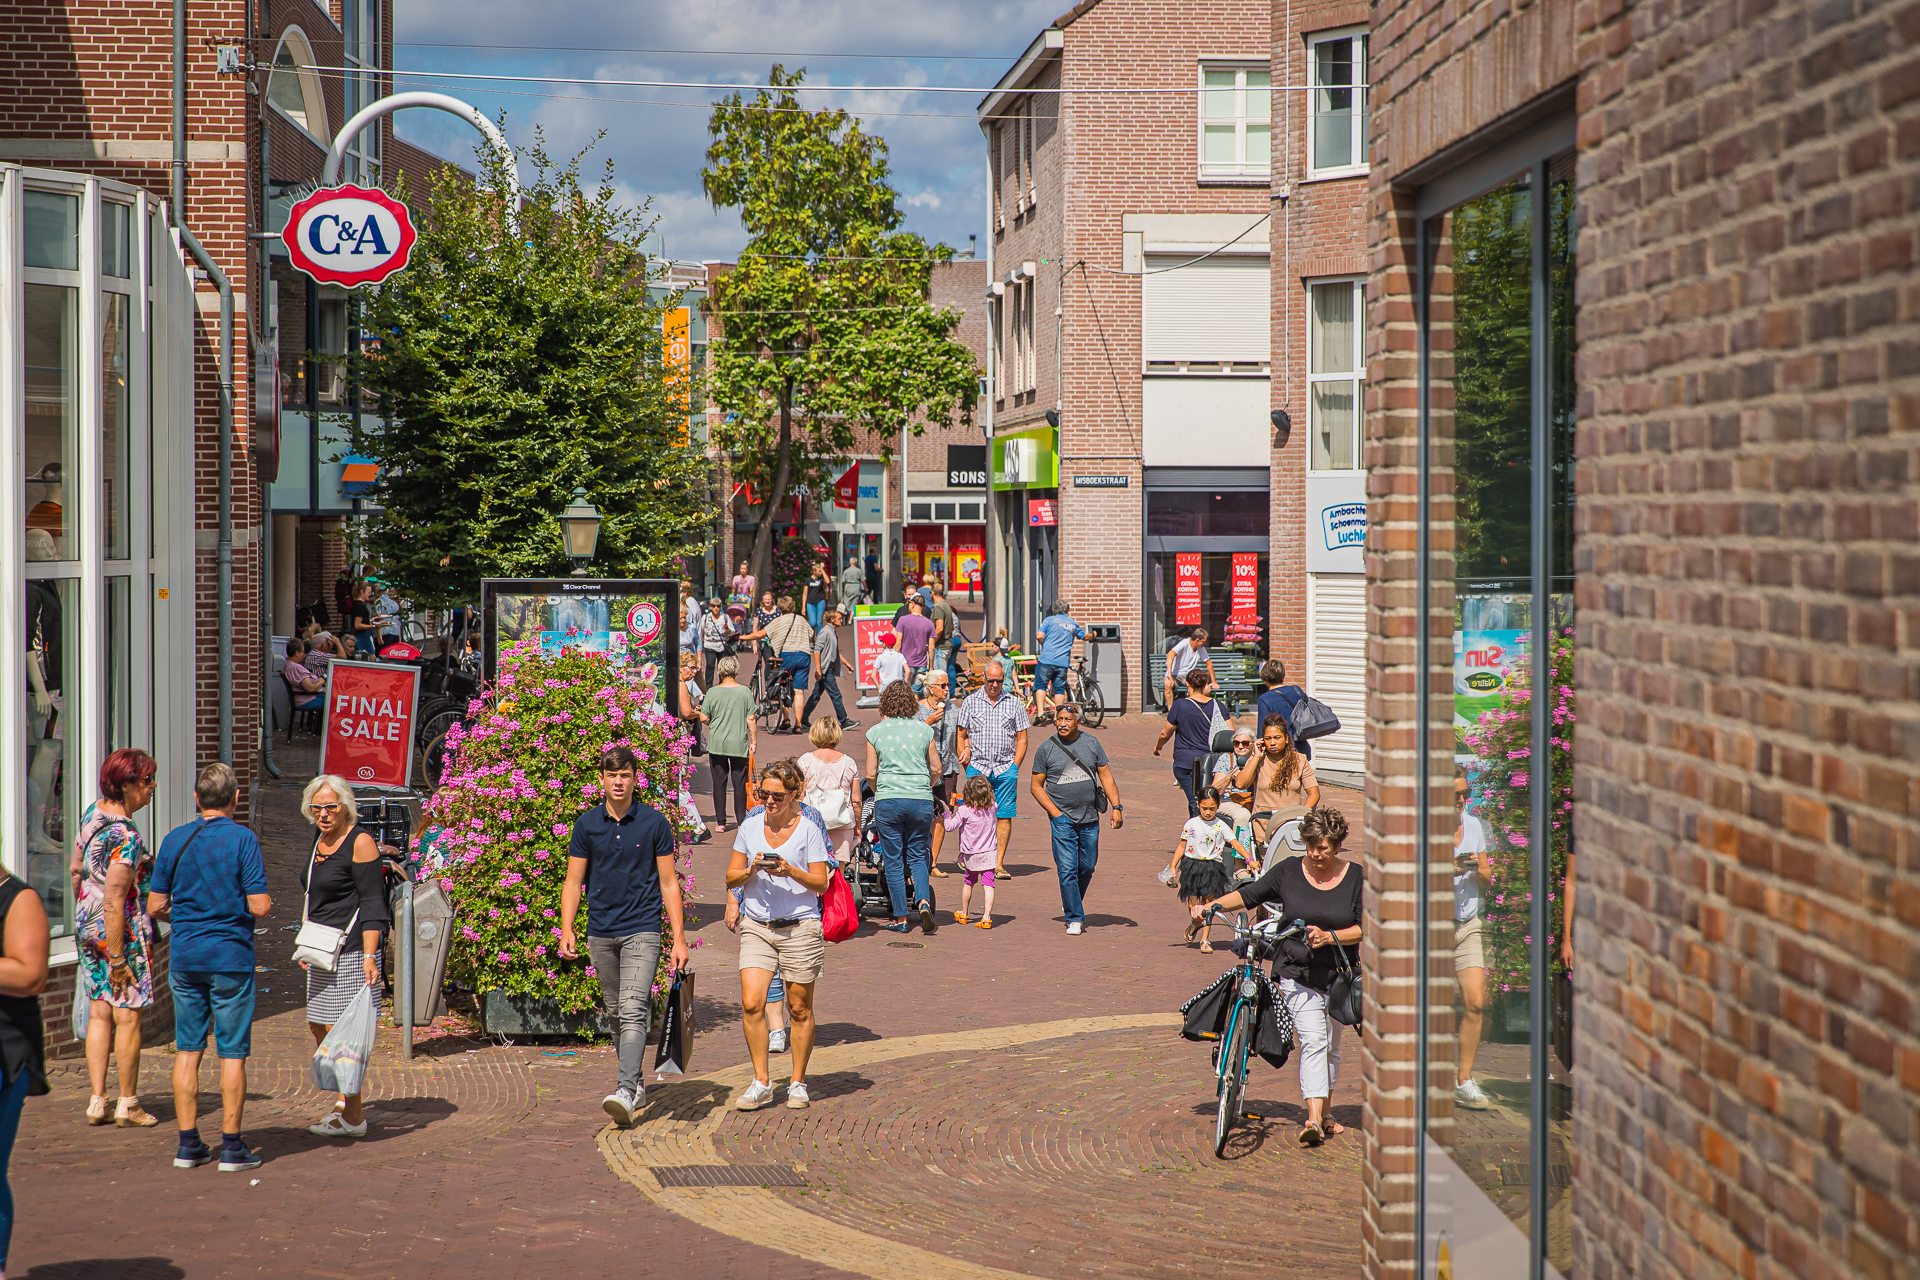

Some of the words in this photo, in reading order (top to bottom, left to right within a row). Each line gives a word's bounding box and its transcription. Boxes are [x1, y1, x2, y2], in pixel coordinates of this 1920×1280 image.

[309, 214, 391, 255] C&A
[950, 471, 986, 484] SONS
[1179, 565, 1199, 576] 10%
[1235, 565, 1255, 576] 10%
[635, 613, 653, 629] 8,1
[336, 695, 408, 719] FINAL
[339, 718, 400, 741] SALE
